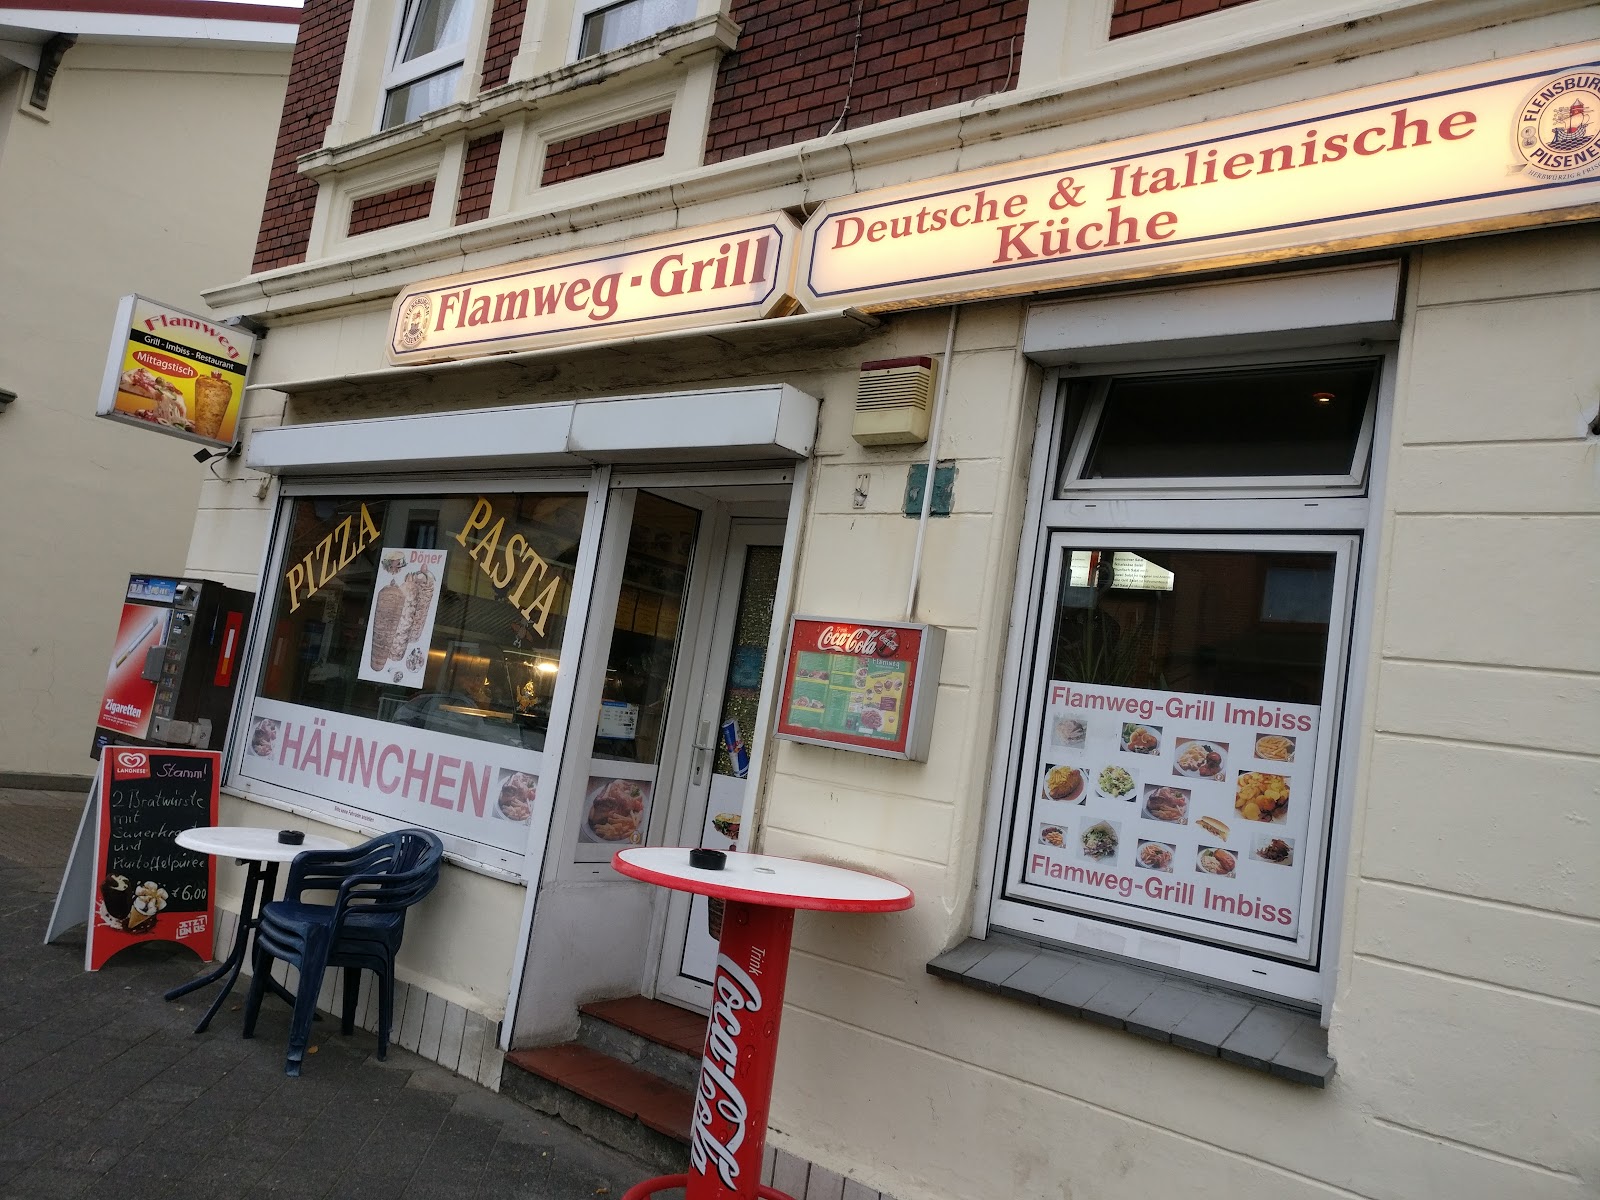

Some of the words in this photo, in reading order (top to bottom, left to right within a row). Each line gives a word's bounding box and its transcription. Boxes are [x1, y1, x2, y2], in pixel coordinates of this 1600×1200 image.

[1523, 76, 1600, 122] FLENSBUR
[831, 190, 1028, 250] Deutsche
[1048, 177, 1086, 211] &
[1106, 107, 1478, 201] Italienische
[993, 206, 1178, 264] Küche
[137, 352, 194, 377] Mittagstisch
[144, 335, 160, 346] Grill
[166, 342, 190, 356] Imbiss
[196, 352, 235, 370] Restaurant
[286, 502, 381, 614] PIZZA
[410, 550, 443, 565] Döner
[456, 496, 561, 638] PASTA
[105, 699, 142, 719] Zigaretten
[1051, 686, 1215, 722] Flamweg-Grill
[1224, 702, 1312, 733] Imbiss
[278, 717, 492, 818] HÄHNCHEN
[112, 790, 124, 808] 2
[113, 810, 140, 825] mit
[114, 840, 142, 852] und
[1031, 854, 1195, 906] Flamweg-Grill
[1204, 887, 1293, 926] Imbiss
[748, 945, 766, 977] Trink
